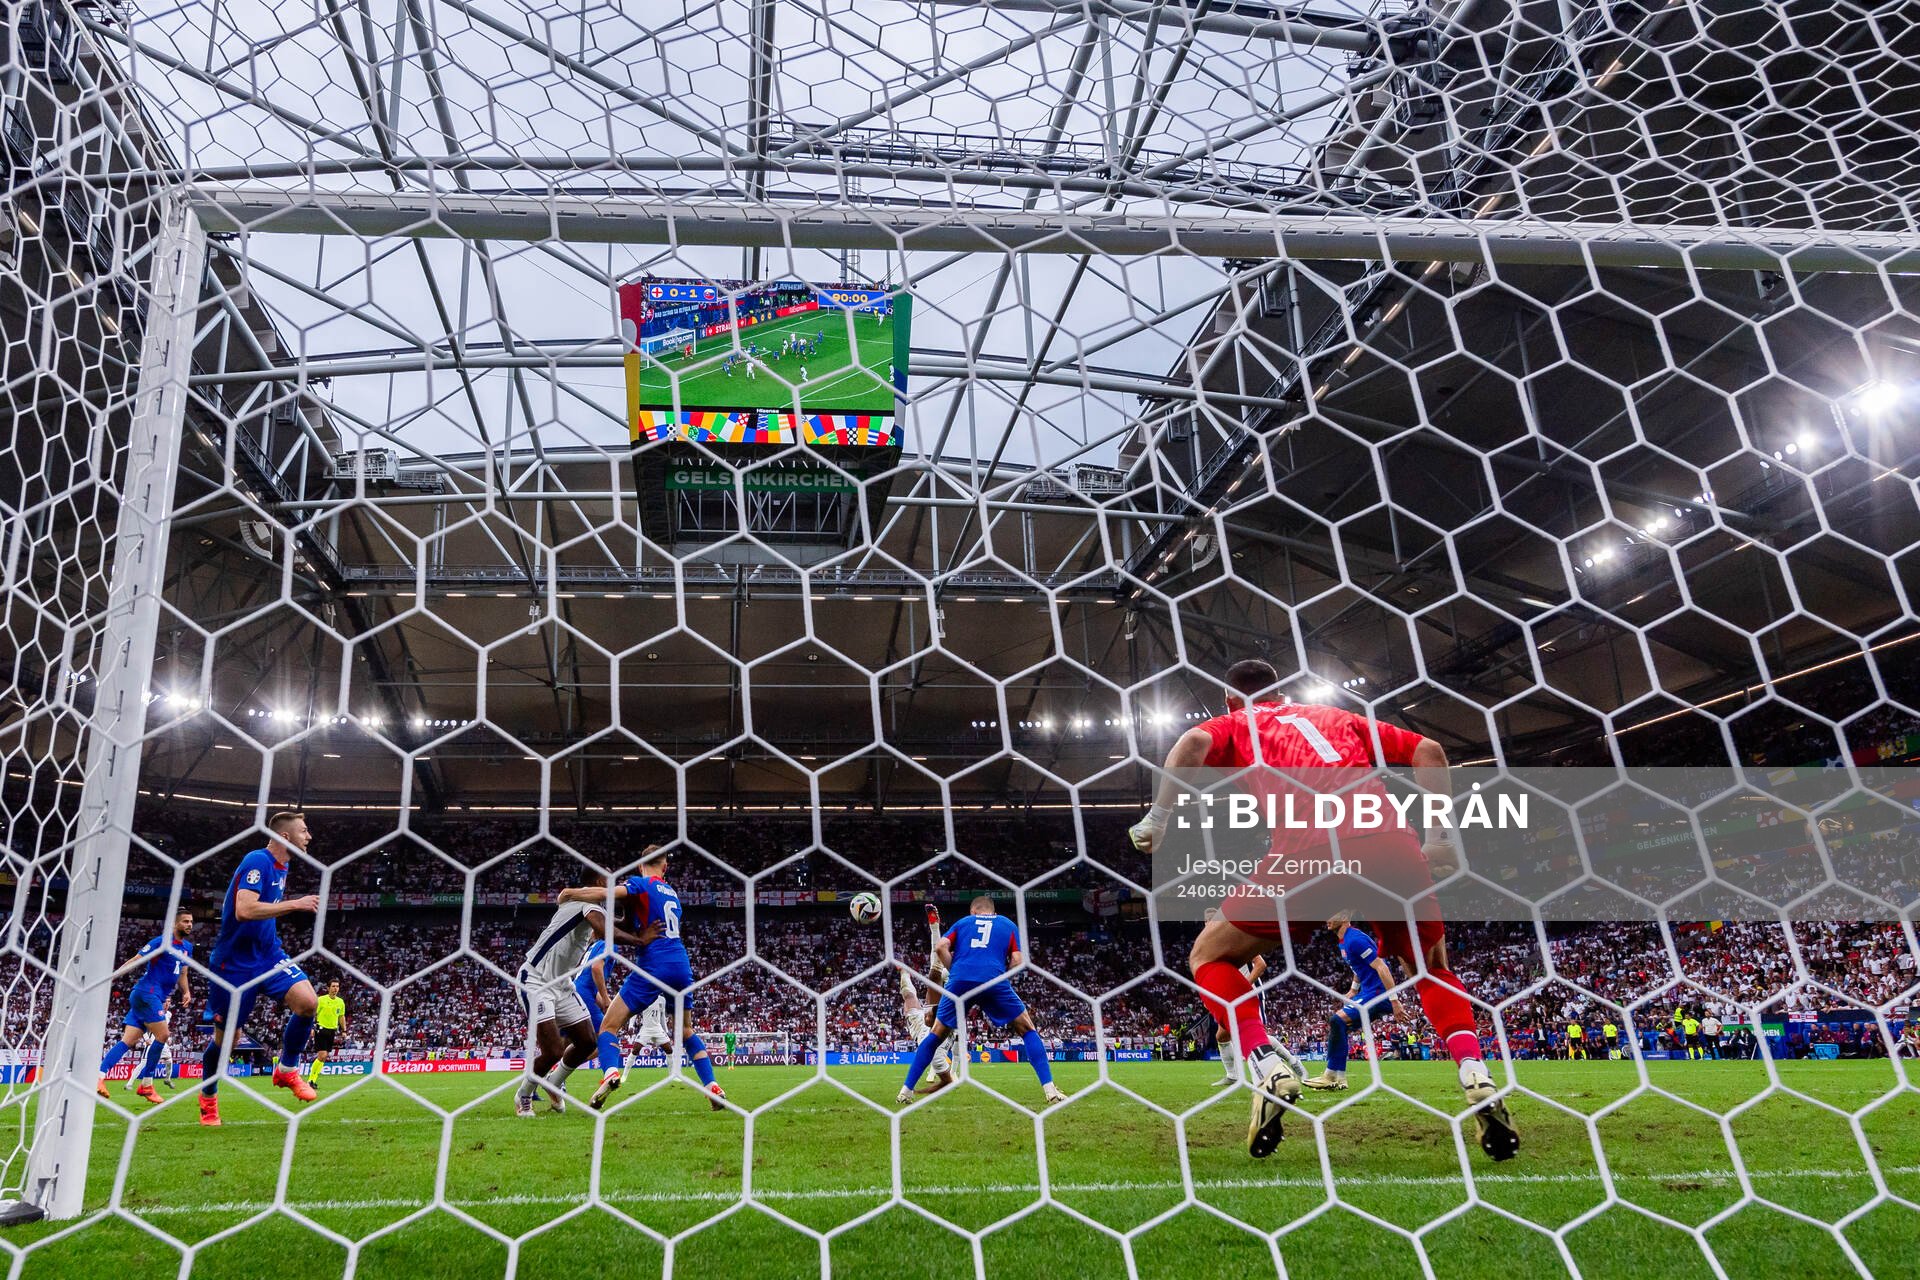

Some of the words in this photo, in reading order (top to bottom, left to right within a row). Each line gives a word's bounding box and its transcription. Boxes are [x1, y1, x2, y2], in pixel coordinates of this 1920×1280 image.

[669, 288, 679, 297] 0
[689, 289, 698, 298] 1
[832, 293, 868, 303] 90:00
[662, 333, 693, 346] Booking.com
[674, 471, 858, 488] GELSNKIRCHEN
[1274, 713, 1343, 764] 1
[1637, 826, 1718, 850] GELSENKIRCEN
[984, 891, 1058, 899] GELSEIRCHEN
[663, 900, 681, 939] 6
[970, 919, 993, 949] 3
[622, 1056, 687, 1067] Boking.cm
[1078, 1051, 1111, 1060] #FOOTLL
[106, 1064, 129, 1080] RAUSS
[298, 1062, 365, 1076] iense
[387, 1061, 434, 1073] Betano
[437, 1063, 481, 1072] SPORTWETTEN
